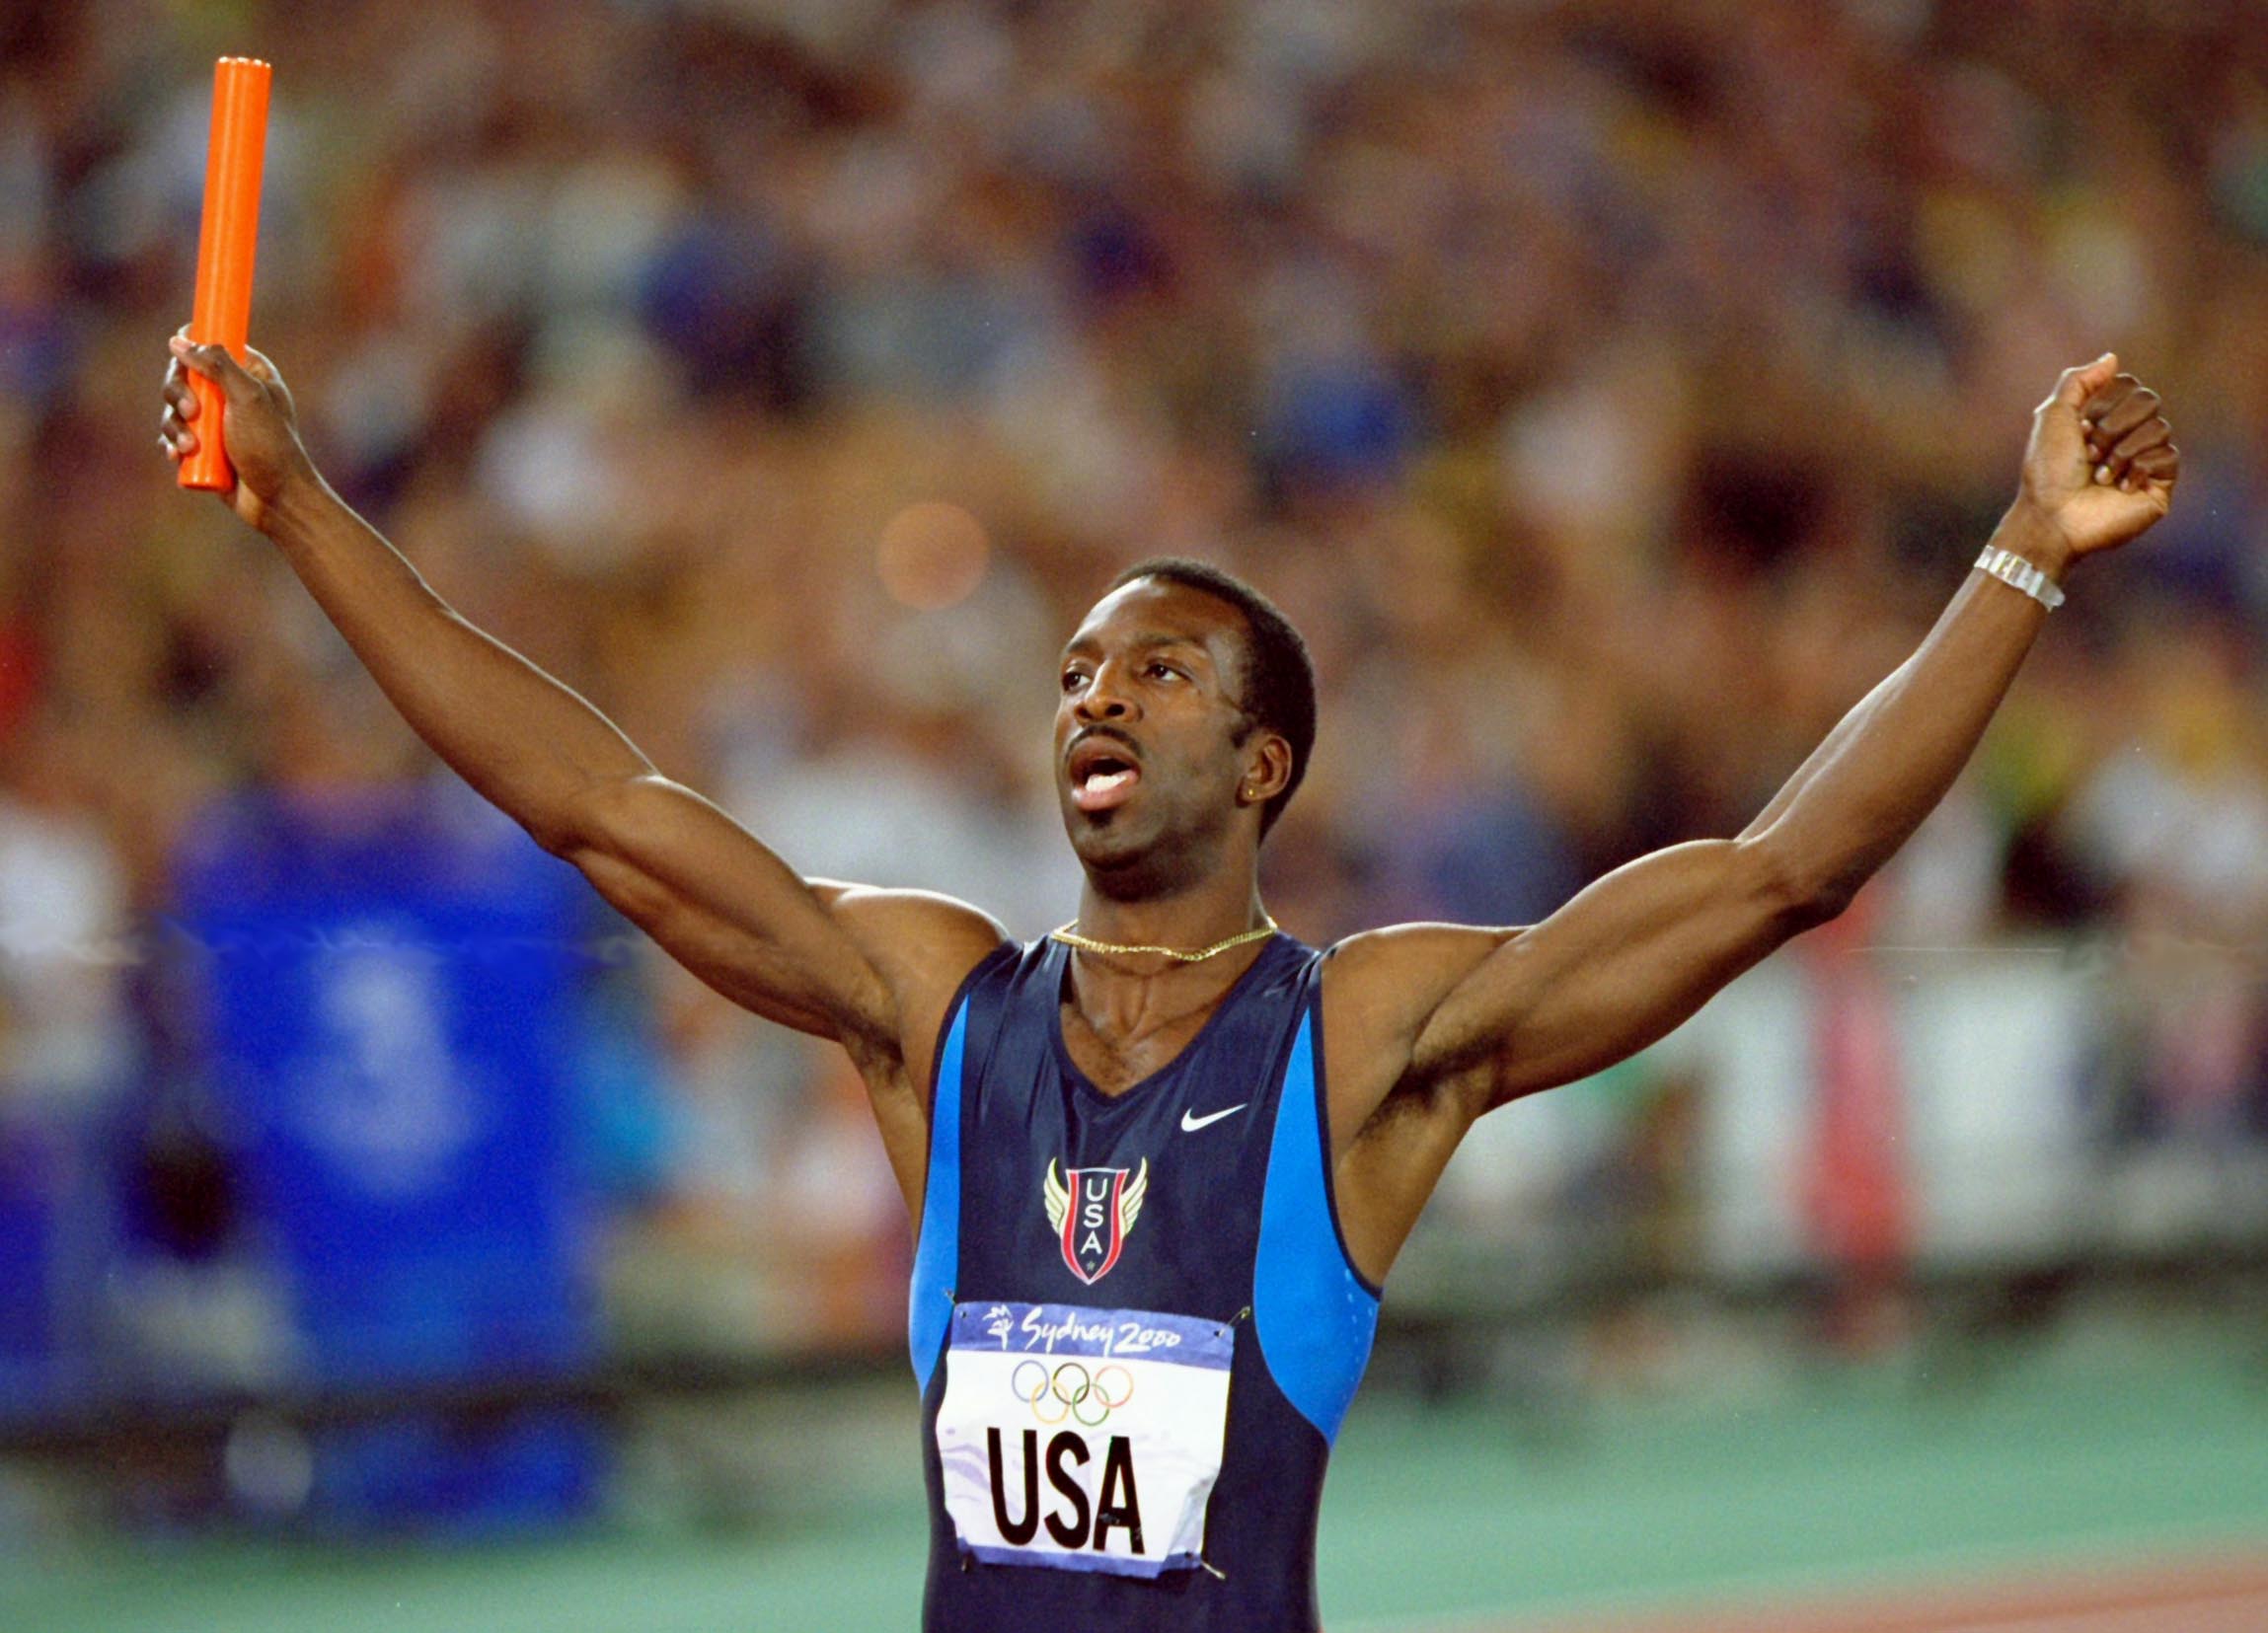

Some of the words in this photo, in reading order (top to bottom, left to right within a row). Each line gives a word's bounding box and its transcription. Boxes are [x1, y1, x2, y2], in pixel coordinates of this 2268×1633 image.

[1081, 1178, 1107, 1254] USA
[1021, 1306, 1114, 1358] Sydney
[1113, 1322, 1181, 1353] 2000
[987, 1427, 1145, 1555] USA
